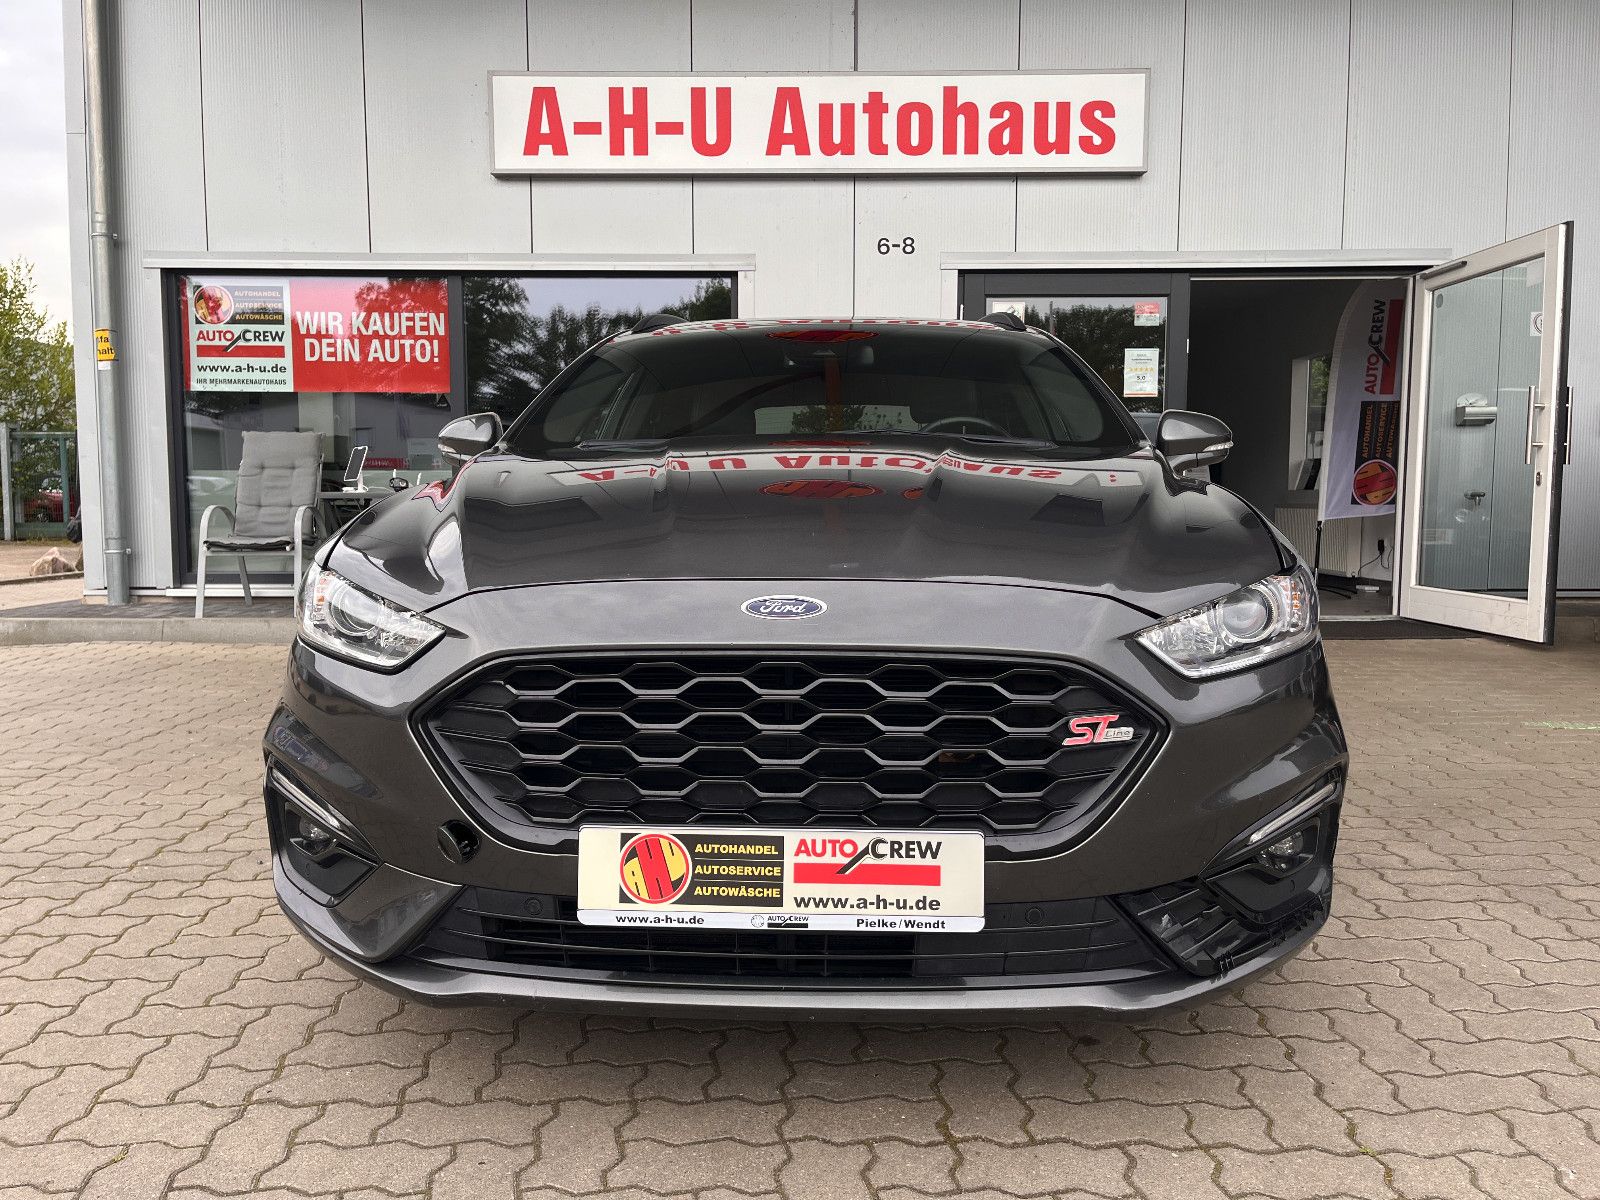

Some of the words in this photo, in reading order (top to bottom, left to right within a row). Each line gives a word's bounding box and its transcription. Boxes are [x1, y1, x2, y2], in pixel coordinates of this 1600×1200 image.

[523, 86, 732, 157] A-H-U
[766, 85, 1116, 157] Autohaus
[877, 237, 916, 255] 6-8
[234, 290, 281, 298] AUTOHANDEL
[295, 310, 344, 335] WIR
[351, 311, 445, 336] KAUFEN
[1367, 299, 1386, 347] CREW
[196, 329, 235, 342] AUTO
[241, 328, 286, 343] CREW
[304, 338, 361, 362] DEIN
[367, 338, 440, 363] AUTO!
[197, 363, 287, 374] www.a-h-u.de
[1364, 353, 1380, 395] AUTO
[209, 378, 287, 386] MEHRMARKENAUTOHAUS
[1361, 404, 1374, 459] AUTOHANDEL
[1375, 402, 1389, 458] AUTOSERVICE
[760, 599, 808, 613] Ford
[1062, 715, 1119, 745] ST
[1105, 729, 1130, 737] Line
[694, 843, 779, 855] AUTOHANDEL
[794, 838, 859, 858] AUTO
[869, 837, 942, 860] CREW
[694, 864, 782, 876] AUTOSERVICE
[693, 885, 781, 898] AUTOWÄSCHE
[794, 894, 941, 911] www.a-h-u.de
[615, 915, 705, 925] www.a-h-u.de
[856, 918, 946, 929] Pielke/Wendt
